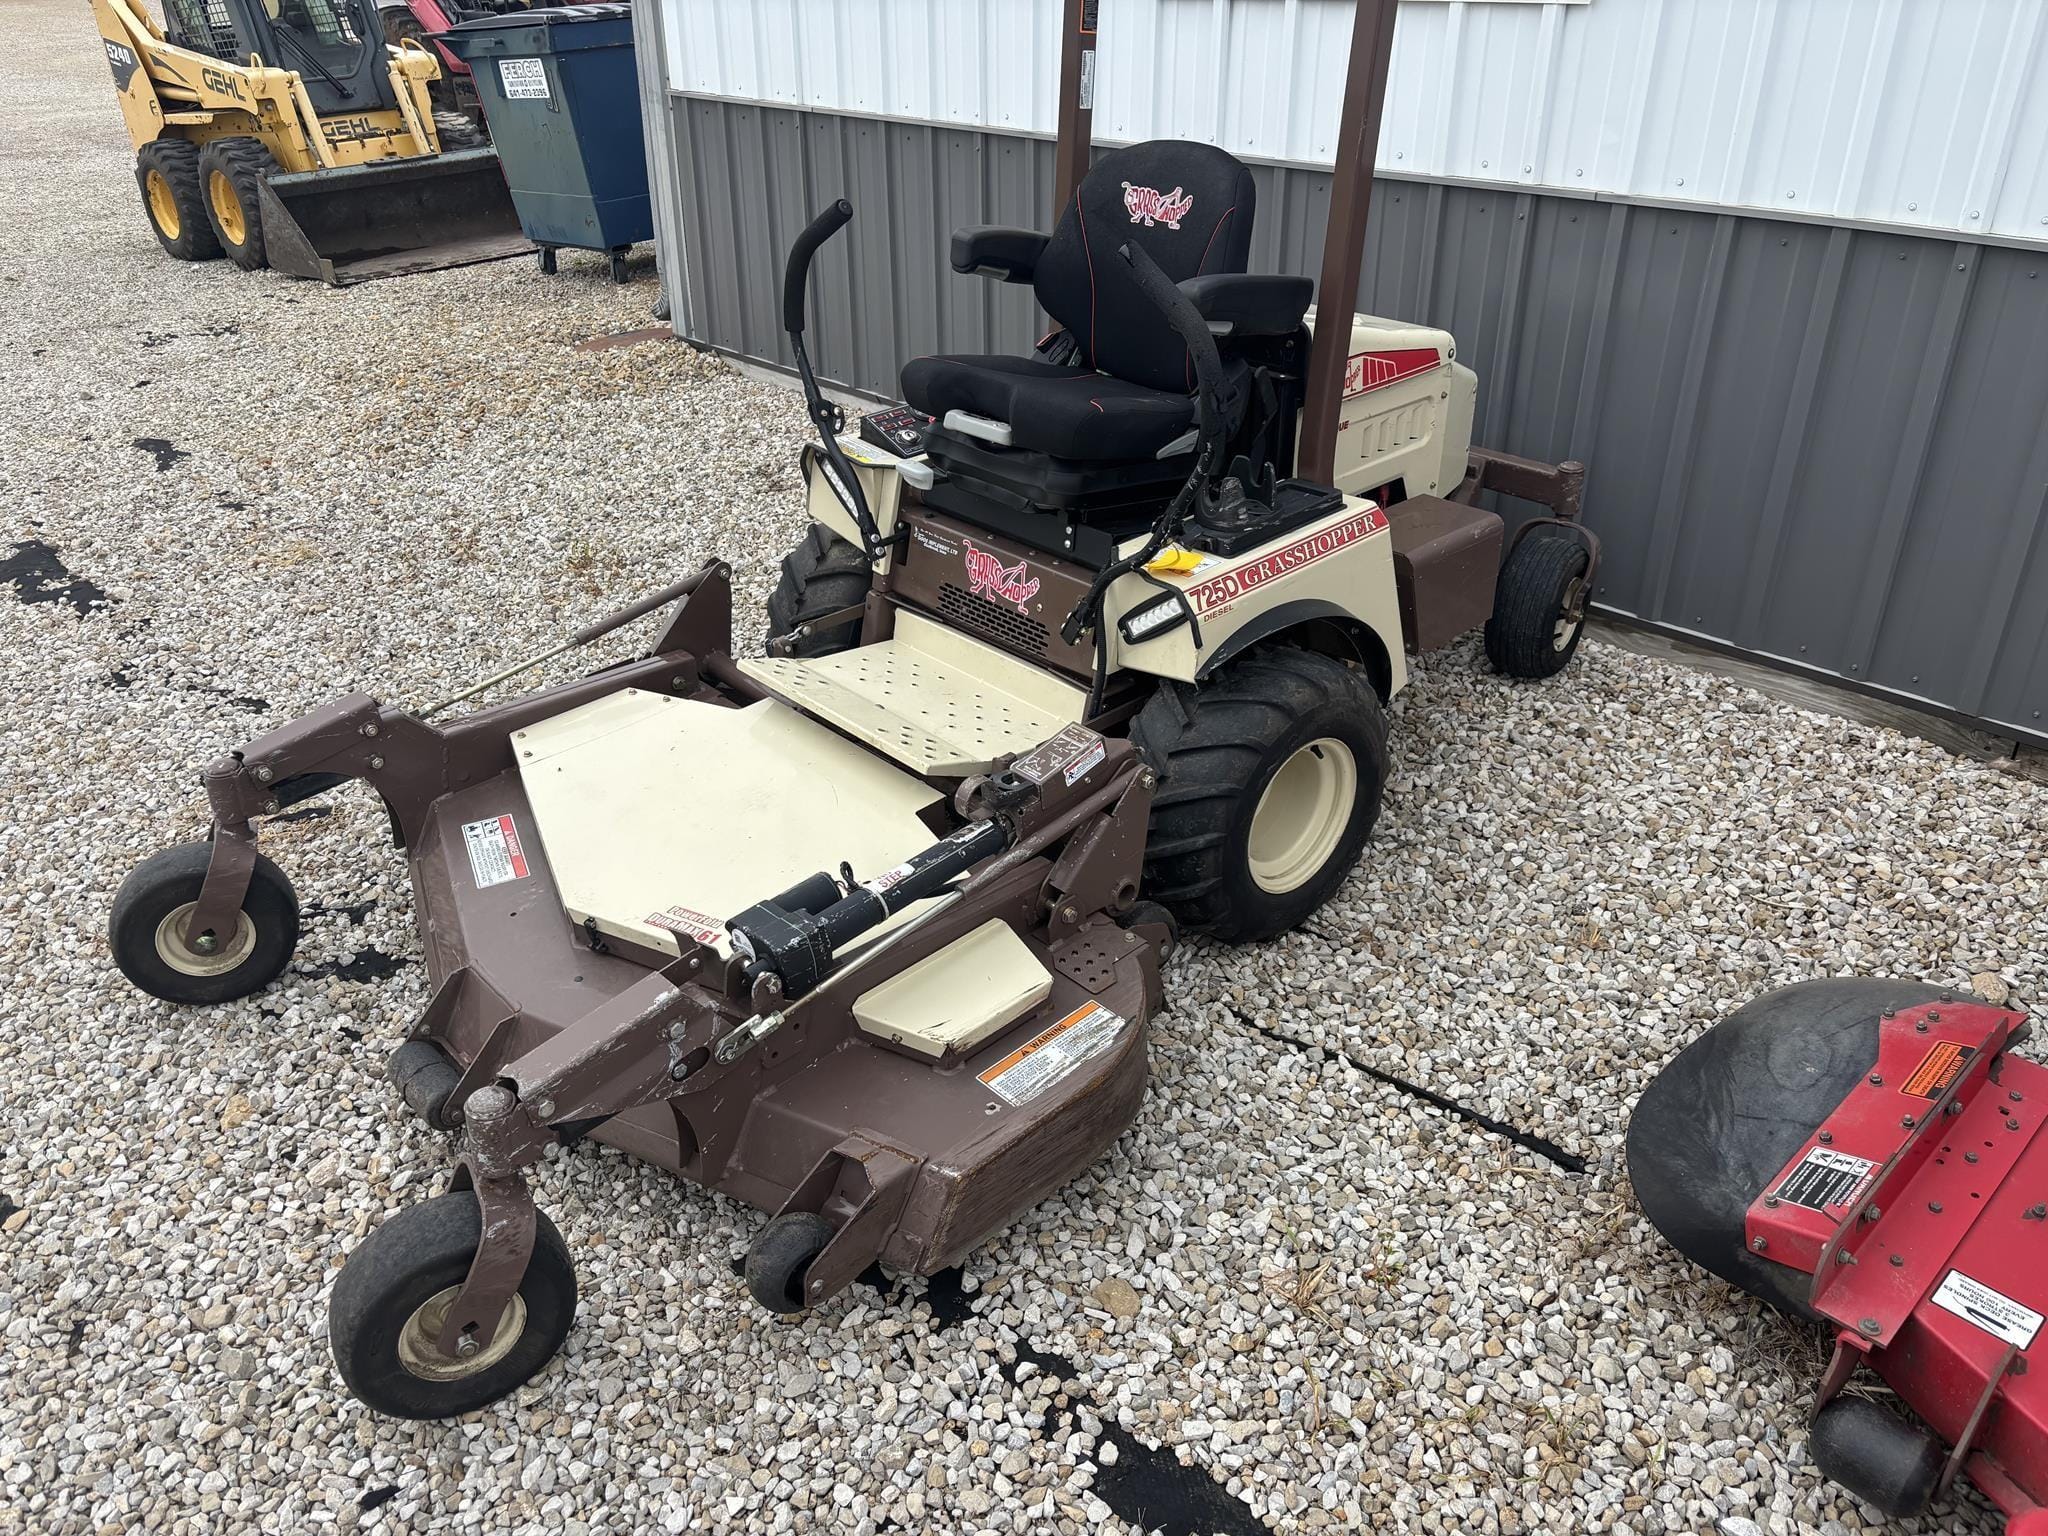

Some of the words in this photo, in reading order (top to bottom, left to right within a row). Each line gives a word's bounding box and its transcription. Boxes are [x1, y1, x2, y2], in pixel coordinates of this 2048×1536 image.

[500, 60, 544, 79] FERCH
[202, 67, 247, 102] GEHL
[320, 117, 381, 137] GEHL
[1189, 574, 1240, 612] 725D
[1243, 513, 1377, 586] GRASSHOPPER
[1203, 604, 1235, 623] DIESEL
[878, 870, 903, 888] STEP
[696, 930, 722, 944] 61
[1030, 1023, 1067, 1049] WARNING
[1934, 1058, 1963, 1089] WARNING
[1943, 1284, 1979, 1305] SPINDLES
[1959, 1283, 1985, 1299] HOURS
[1969, 1293, 2004, 1314] STROKES
[1980, 1303, 2001, 1317] DECK
[2001, 1306, 2026, 1321] EVERY
[2002, 1316, 2033, 1334] GREASE
